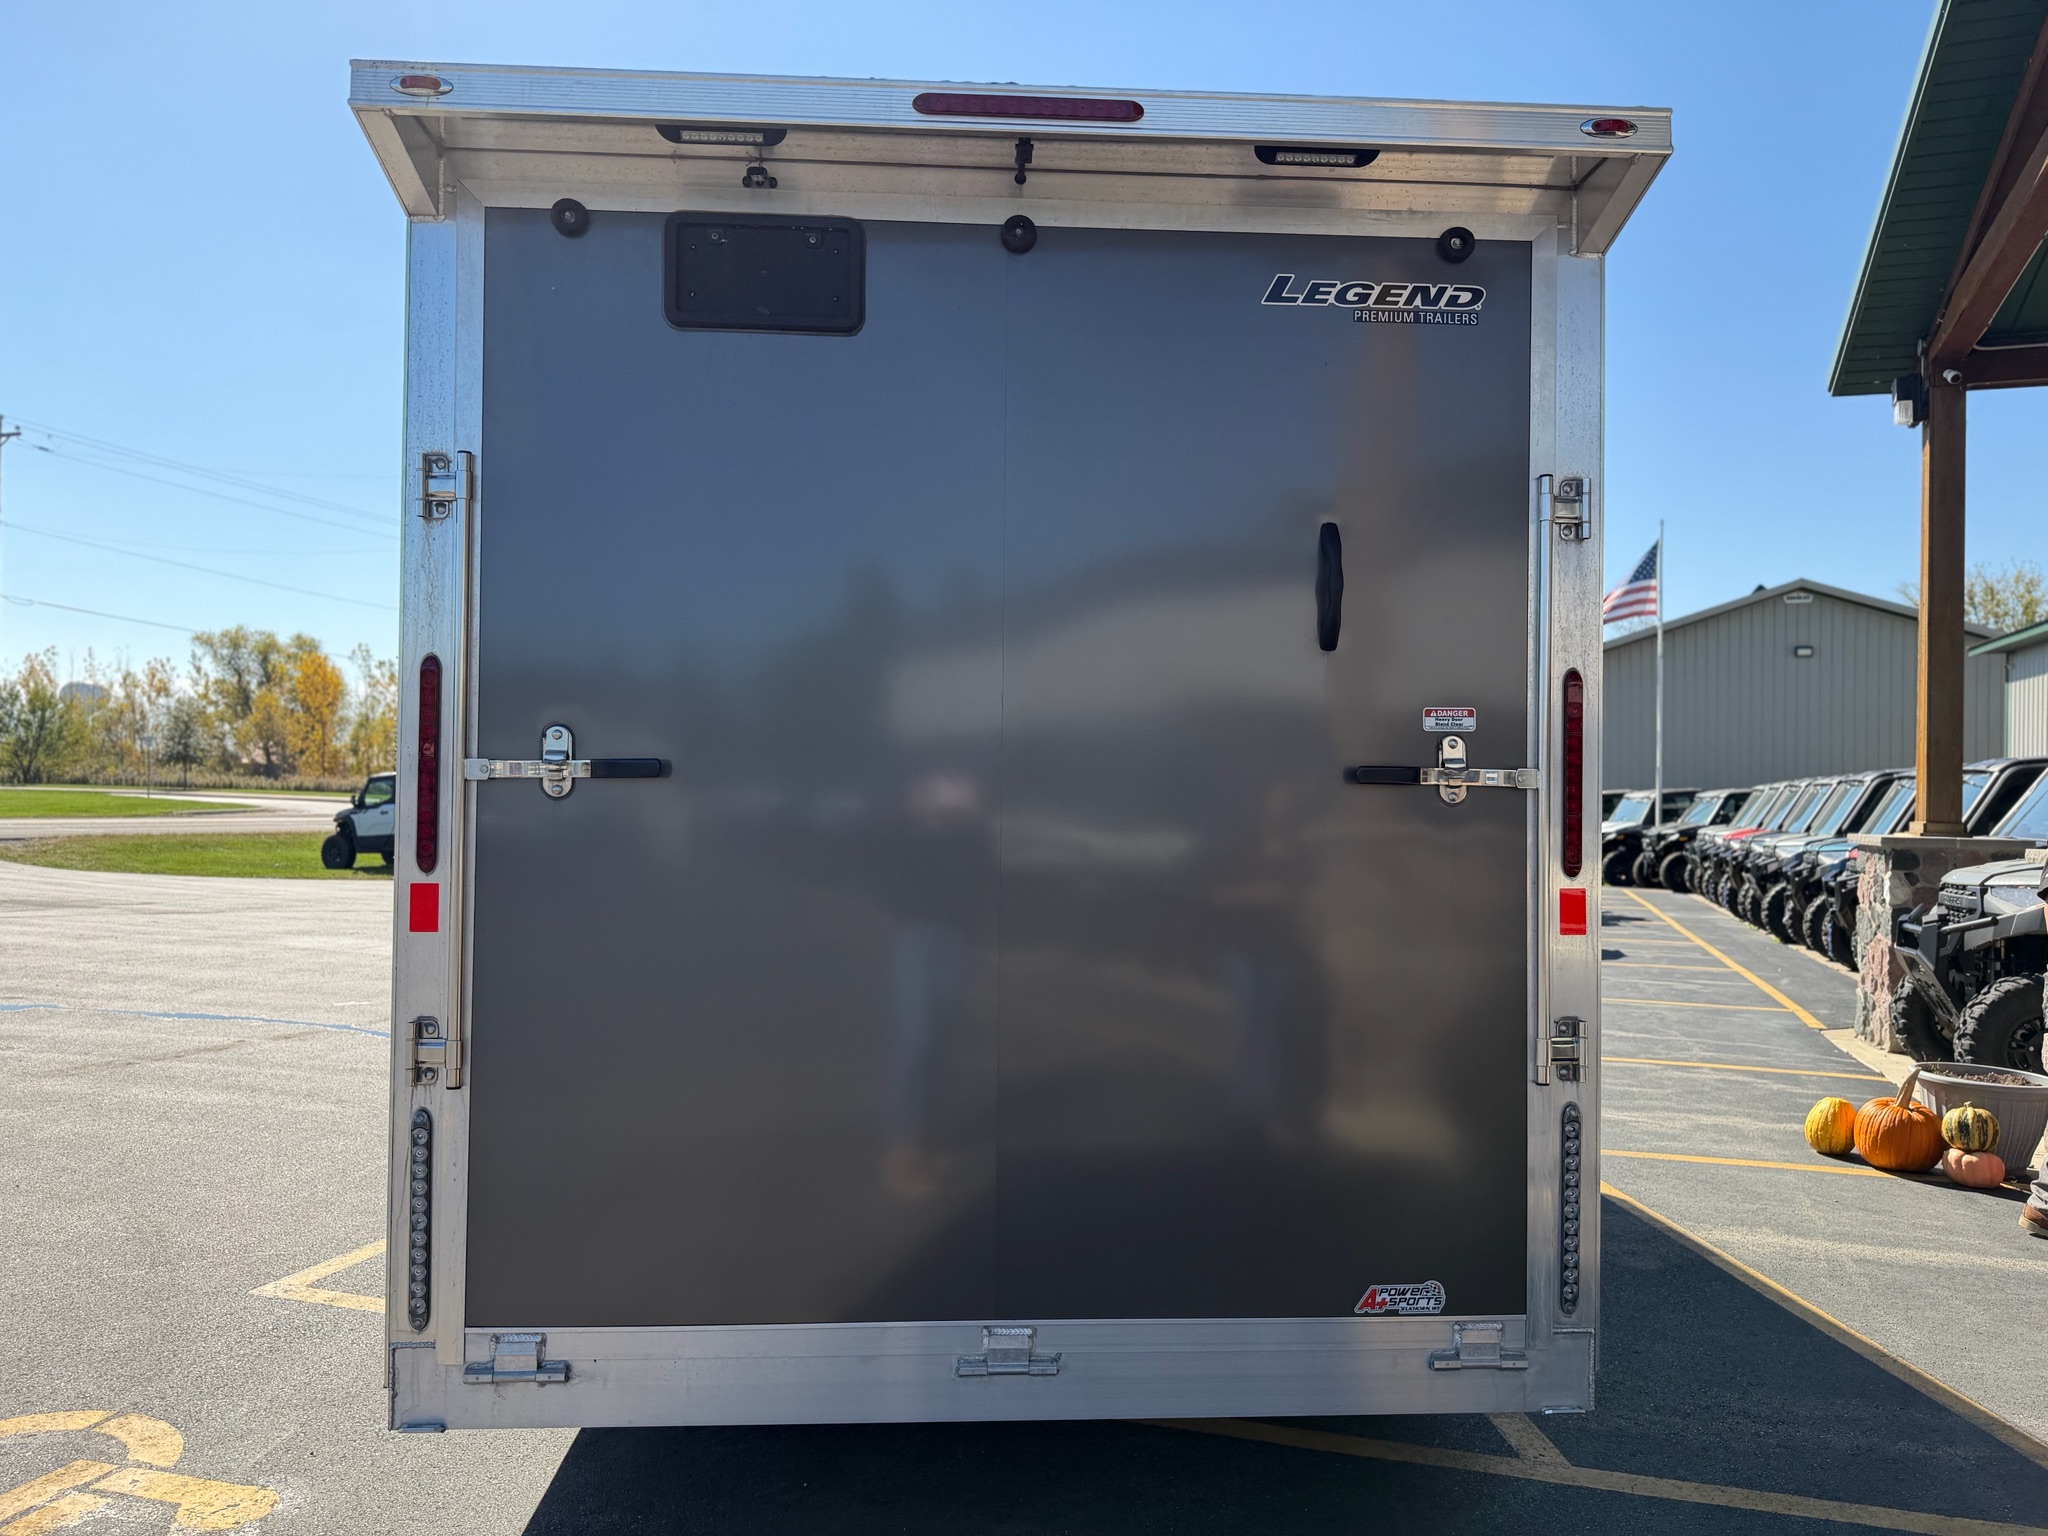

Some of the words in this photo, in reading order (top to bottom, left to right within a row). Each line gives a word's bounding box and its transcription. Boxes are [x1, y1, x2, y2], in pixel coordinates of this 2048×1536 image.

[1261, 274, 1486, 310] LEGEND
[1354, 310, 1414, 323] PREMIUM
[1419, 312, 1478, 325] TRAILERS
